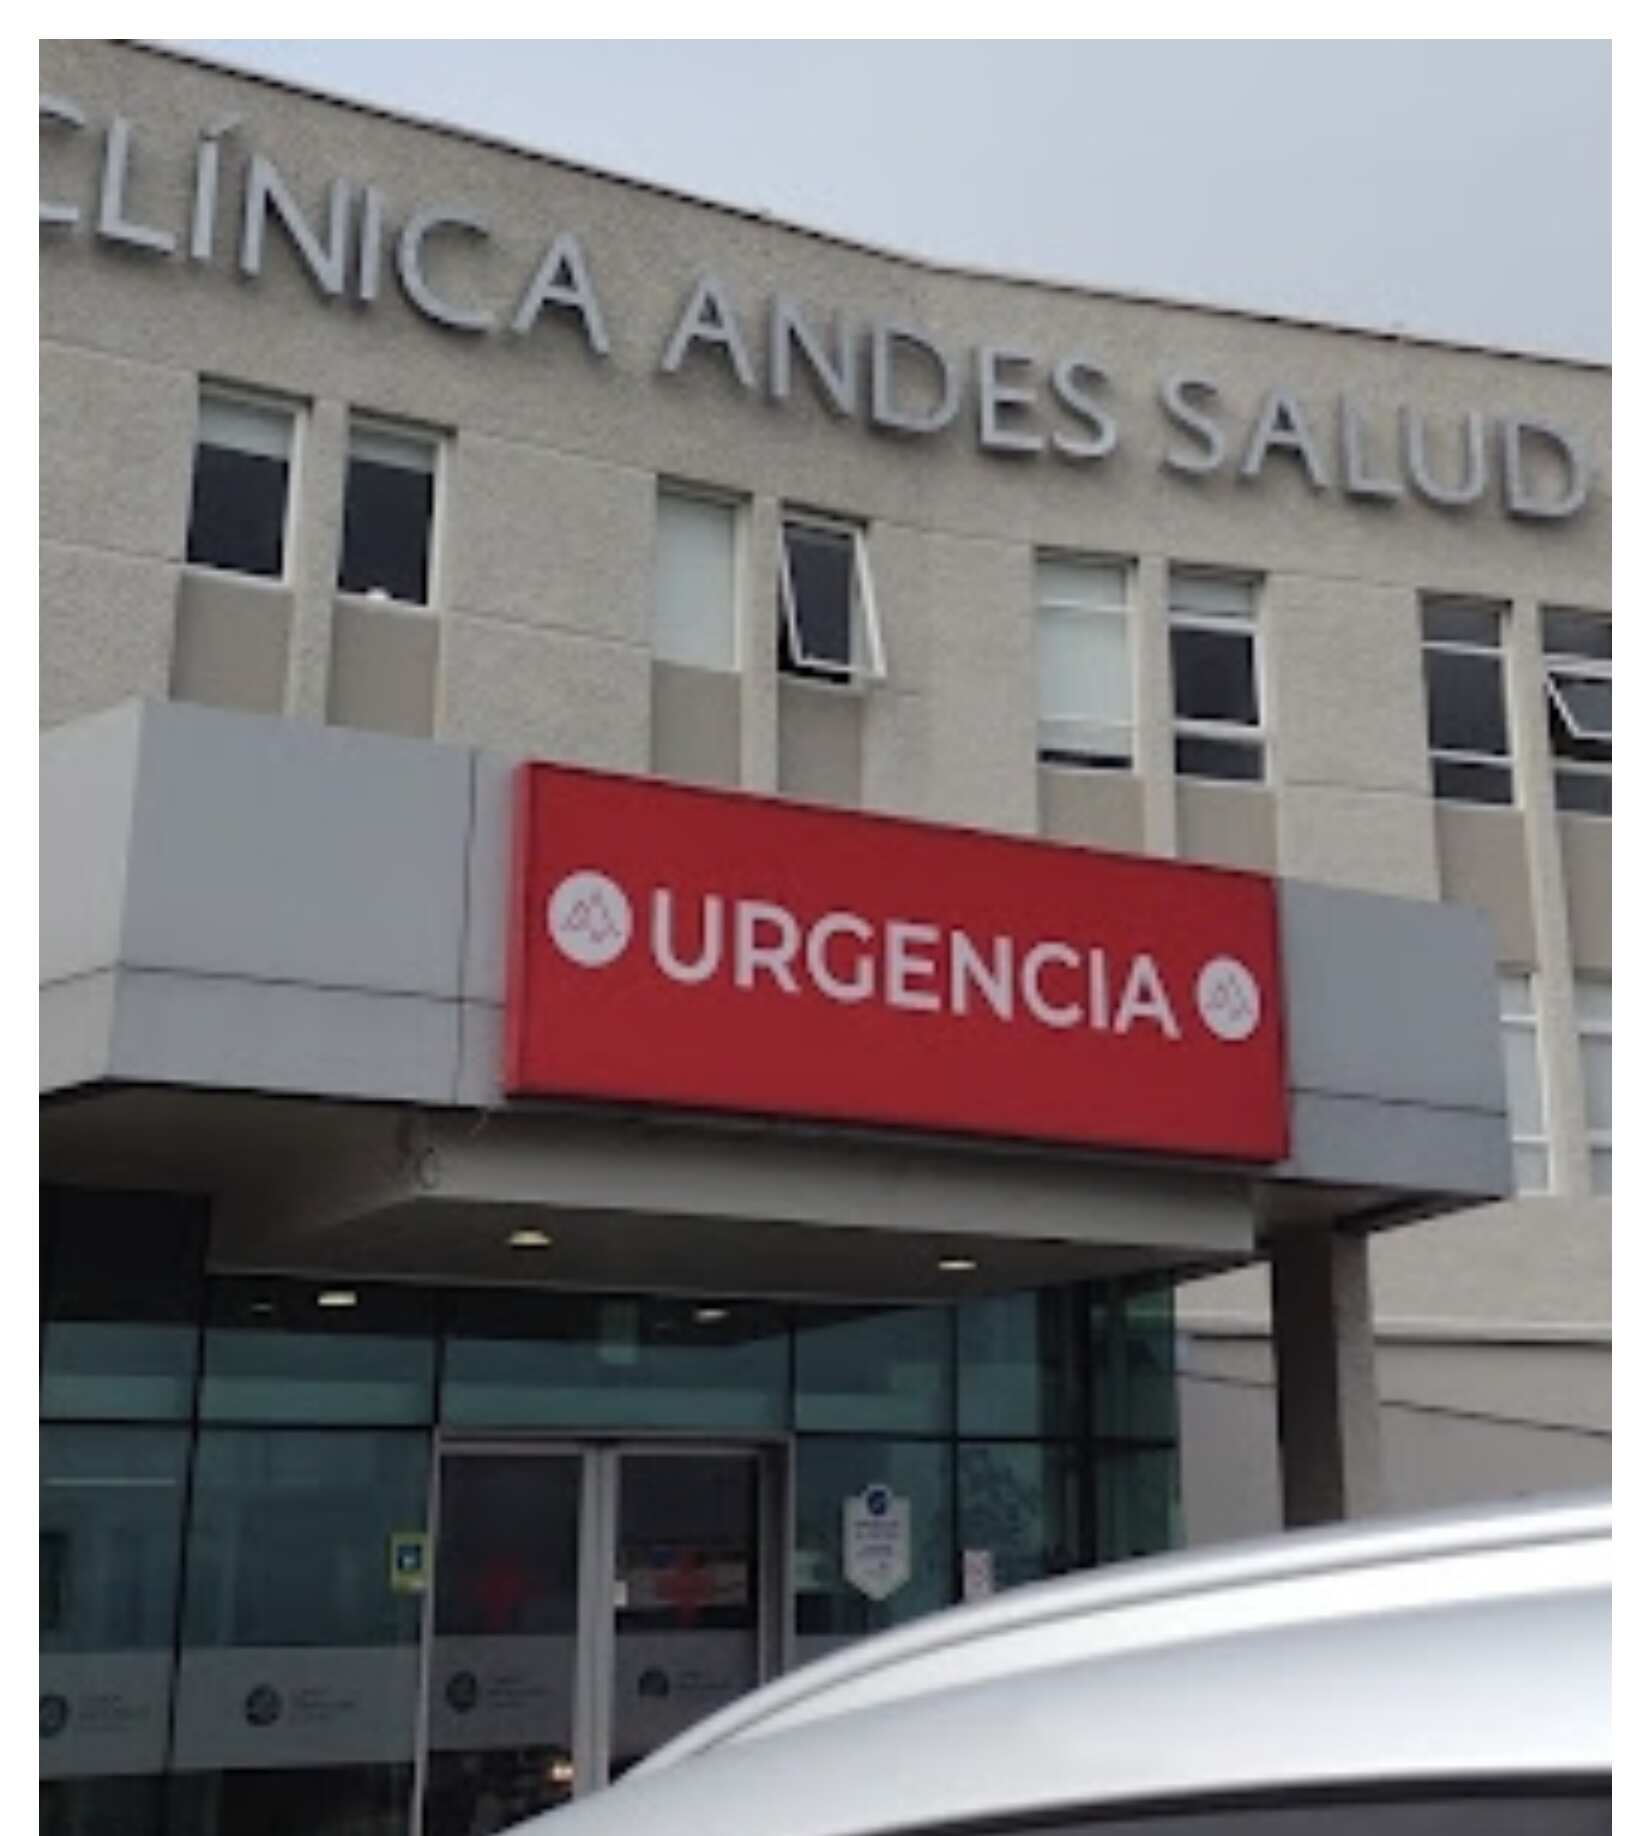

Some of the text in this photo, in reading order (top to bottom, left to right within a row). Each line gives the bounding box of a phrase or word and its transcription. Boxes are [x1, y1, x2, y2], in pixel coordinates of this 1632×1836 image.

[662, 274, 1117, 459] ANDES
[1158, 370, 1590, 519] SALUD
[651, 889, 1180, 1039] URGENCIA
